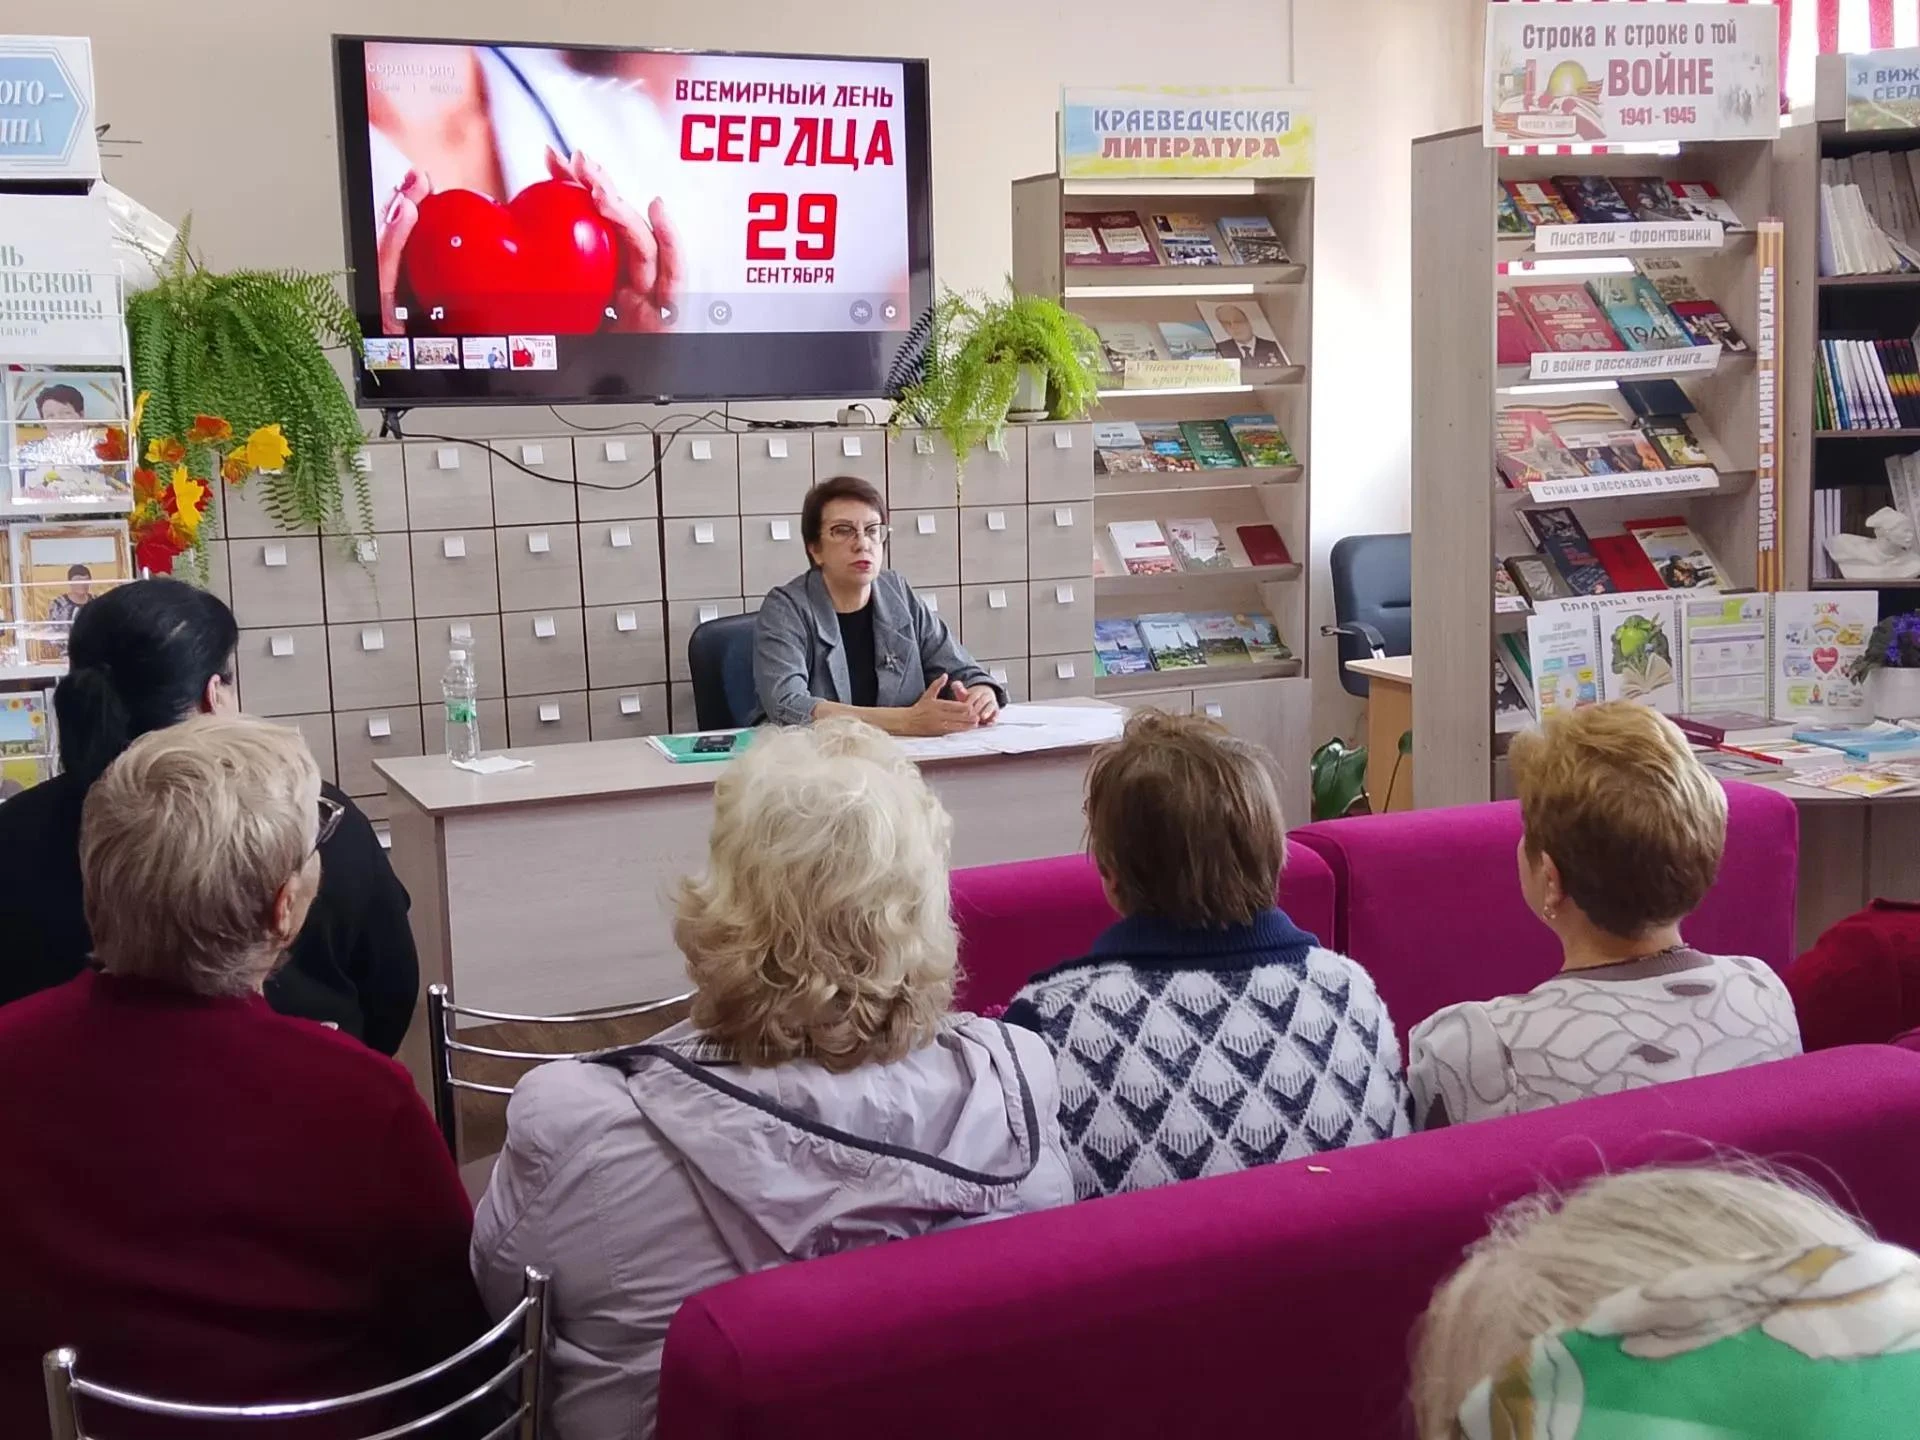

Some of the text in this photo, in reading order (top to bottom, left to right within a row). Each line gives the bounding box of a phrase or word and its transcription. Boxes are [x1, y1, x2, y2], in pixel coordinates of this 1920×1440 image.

[1522, 18, 1737, 51] Строка к строке о той
[1608, 51, 1714, 97] ВОЙНЕ
[1857, 67, 1920, 86] Я ВИЖ
[675, 79, 894, 108] ВСЕМИРНЫЙ ДЕНЬ
[1094, 109, 1290, 133] КРАЕВЕДЧЕСКАЯ
[1619, 106, 1653, 126] 1941
[1663, 106, 1697, 125] 1945
[680, 114, 894, 172] СЕРДЦА
[1102, 137, 1281, 159] ЛИТЕРАТУРА
[746, 192, 838, 260] 29
[1551, 230, 1615, 246] Писатели
[1629, 228, 1711, 245] фронтовики
[746, 267, 834, 283] СЕНТЯБРЯ
[1759, 267, 1774, 360] ЧИТАЕМ
[1624, 325, 1669, 344] 1941
[1541, 359, 1548, 373] О
[1553, 357, 1590, 373] войне
[1594, 355, 1663, 373] расскажет
[1759, 453, 1774, 468] О
[1543, 484, 1578, 497] Стихи
[1593, 478, 1652, 493] рассказы
[1665, 473, 1701, 486] войне
[1759, 477, 1777, 552] ВОЙНЕ
